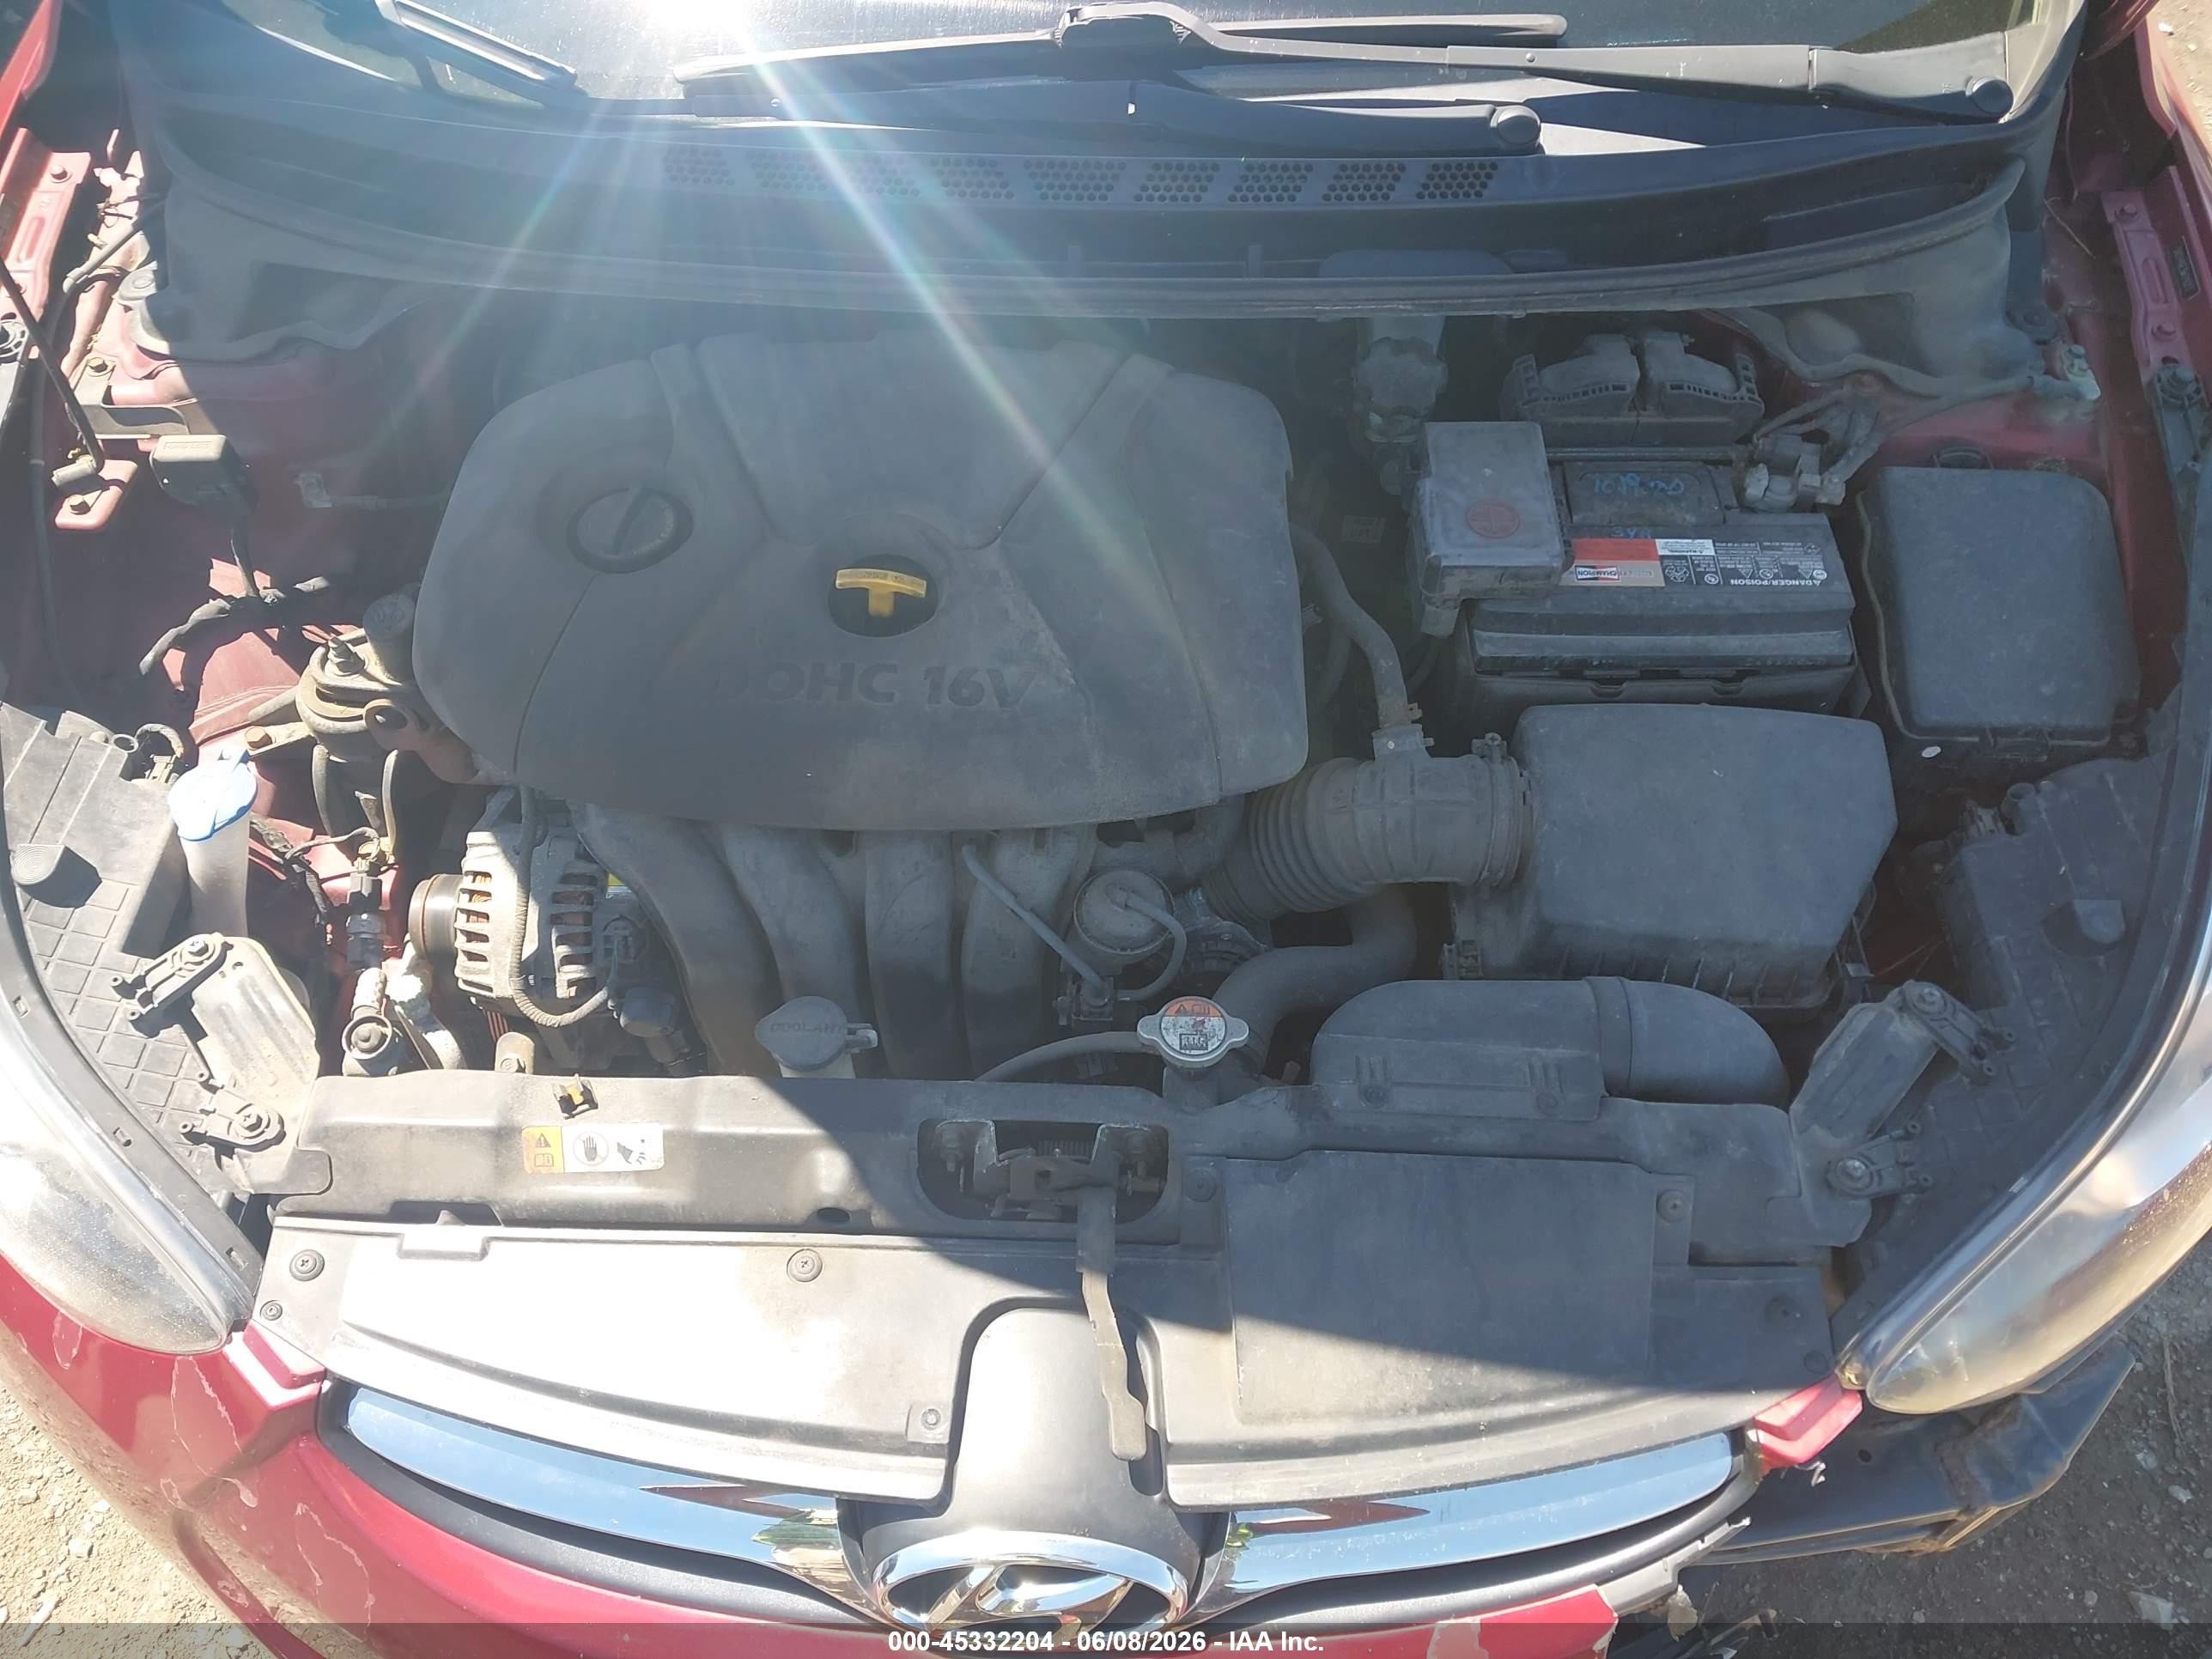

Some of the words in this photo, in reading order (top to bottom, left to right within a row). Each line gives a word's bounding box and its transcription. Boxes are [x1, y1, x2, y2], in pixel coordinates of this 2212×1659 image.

[1577, 569, 1618, 578] CHAMPION
[1730, 578, 1813, 586] DANGER/POISON
[712, 660, 899, 707] DOHC
[922, 664, 1037, 710] 16V
[769, 1020, 843, 1034] COOLANT
